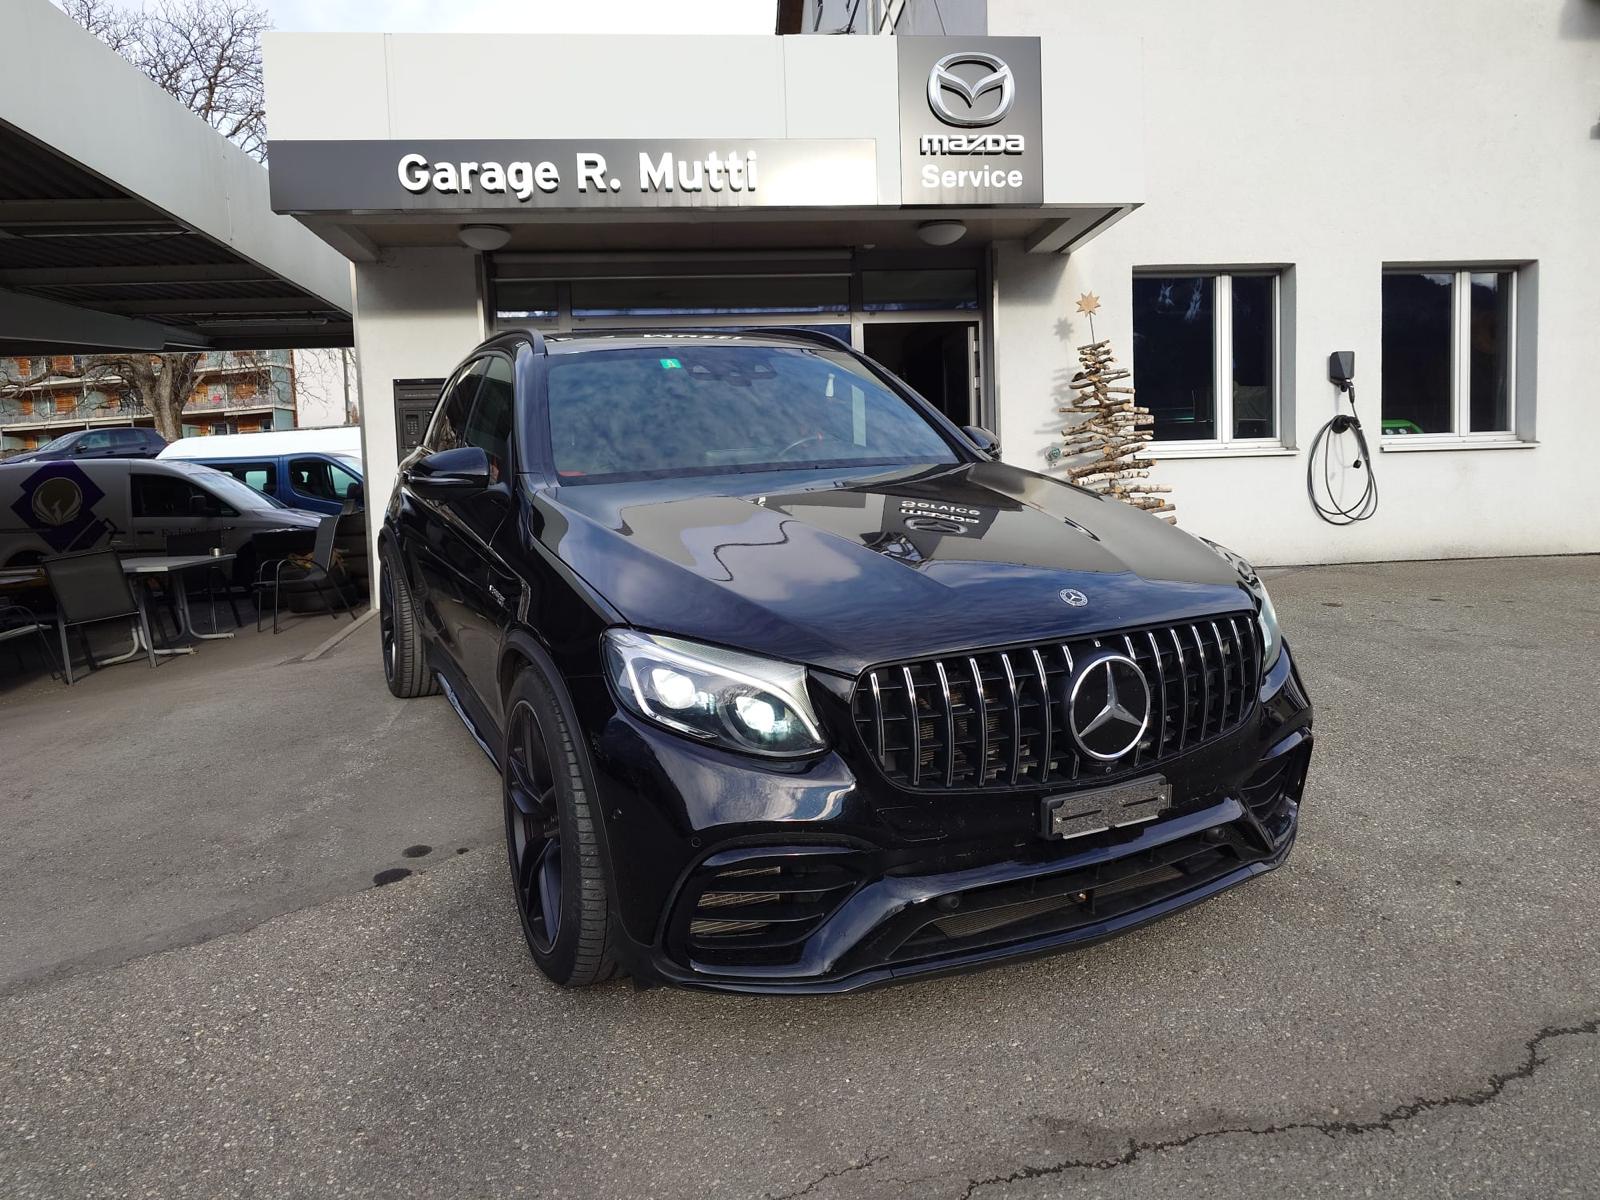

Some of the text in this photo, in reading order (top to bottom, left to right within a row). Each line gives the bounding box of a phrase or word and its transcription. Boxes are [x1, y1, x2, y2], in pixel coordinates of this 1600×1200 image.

[397, 150, 758, 201] Garage R. Mutti
[921, 164, 1023, 188] Service
